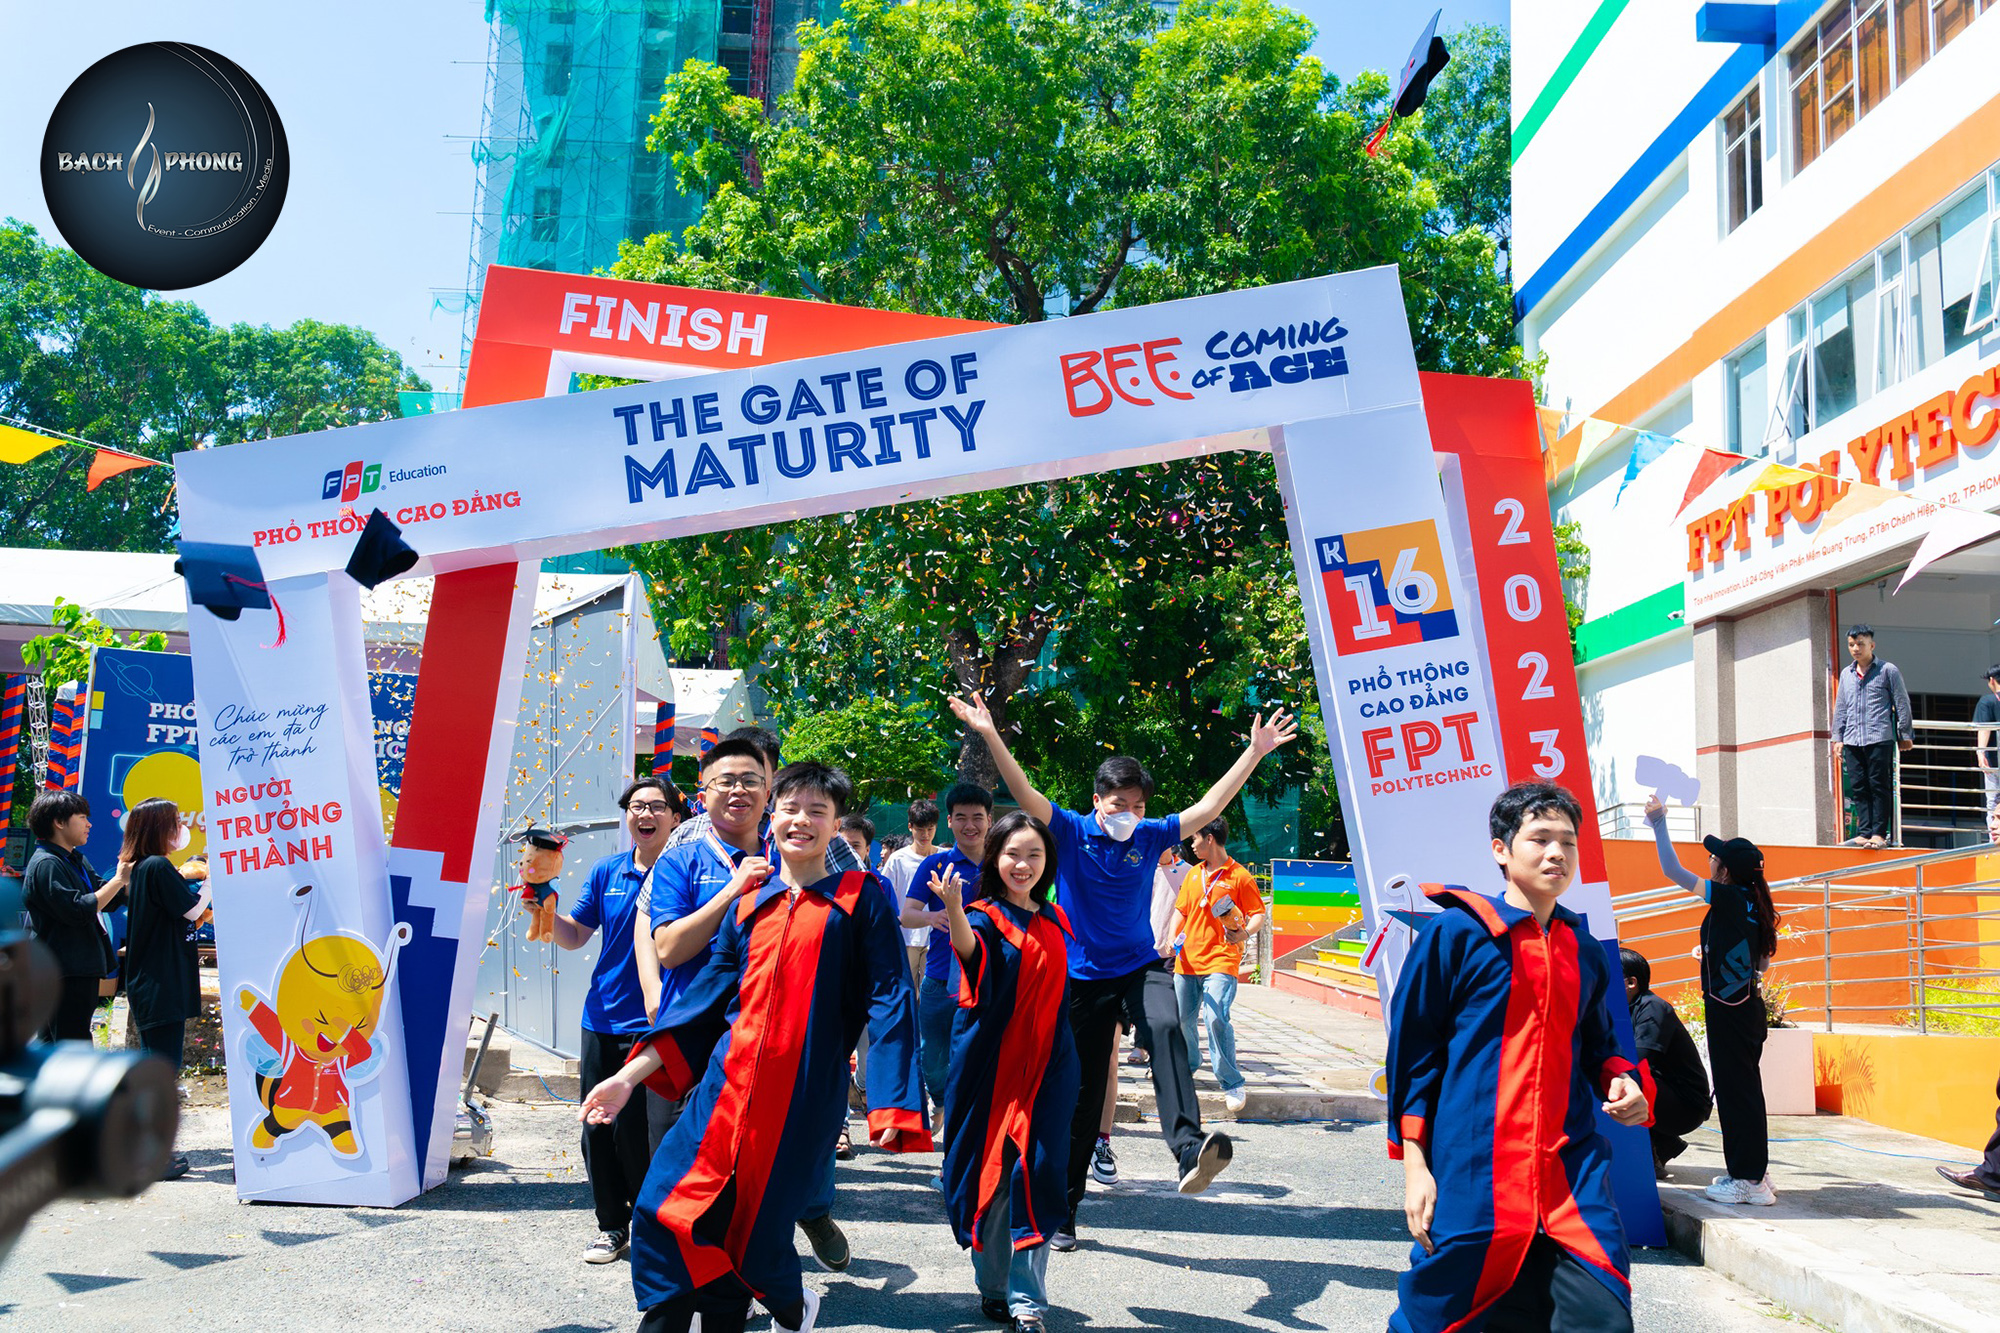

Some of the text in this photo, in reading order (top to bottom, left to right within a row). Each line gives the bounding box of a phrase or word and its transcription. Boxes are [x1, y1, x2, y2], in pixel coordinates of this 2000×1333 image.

[559, 291, 768, 357] FINISH
[1205, 316, 1349, 360] COMING
[1191, 346, 1349, 393] OF AGE
[613, 352, 978, 446] THE GATE OF
[624, 400, 986, 504] MATURITY
[1686, 364, 2000, 572] FPT POLYTEC
[323, 464, 447, 499] FPT Education
[253, 489, 522, 547] PHỔ THÔN CAO ĐẲNG
[1322, 541, 1344, 565] K
[1344, 546, 1438, 641] 16
[1348, 660, 1470, 695] PHỔ THÔNG
[214, 703, 329, 732] Chúc mừng
[1360, 682, 1469, 718] CAO ĐẲNG
[146, 723, 198, 745] FPT
[209, 733, 242, 747] các
[249, 731, 276, 742] em
[261, 737, 318, 767] thành
[1361, 711, 1479, 778] FPT
[215, 777, 293, 807] NGƯỜI
[1371, 763, 1493, 796] POLYTECHNIC
[216, 800, 343, 840] TRƯỞNG
[219, 835, 333, 876] THÀNH
